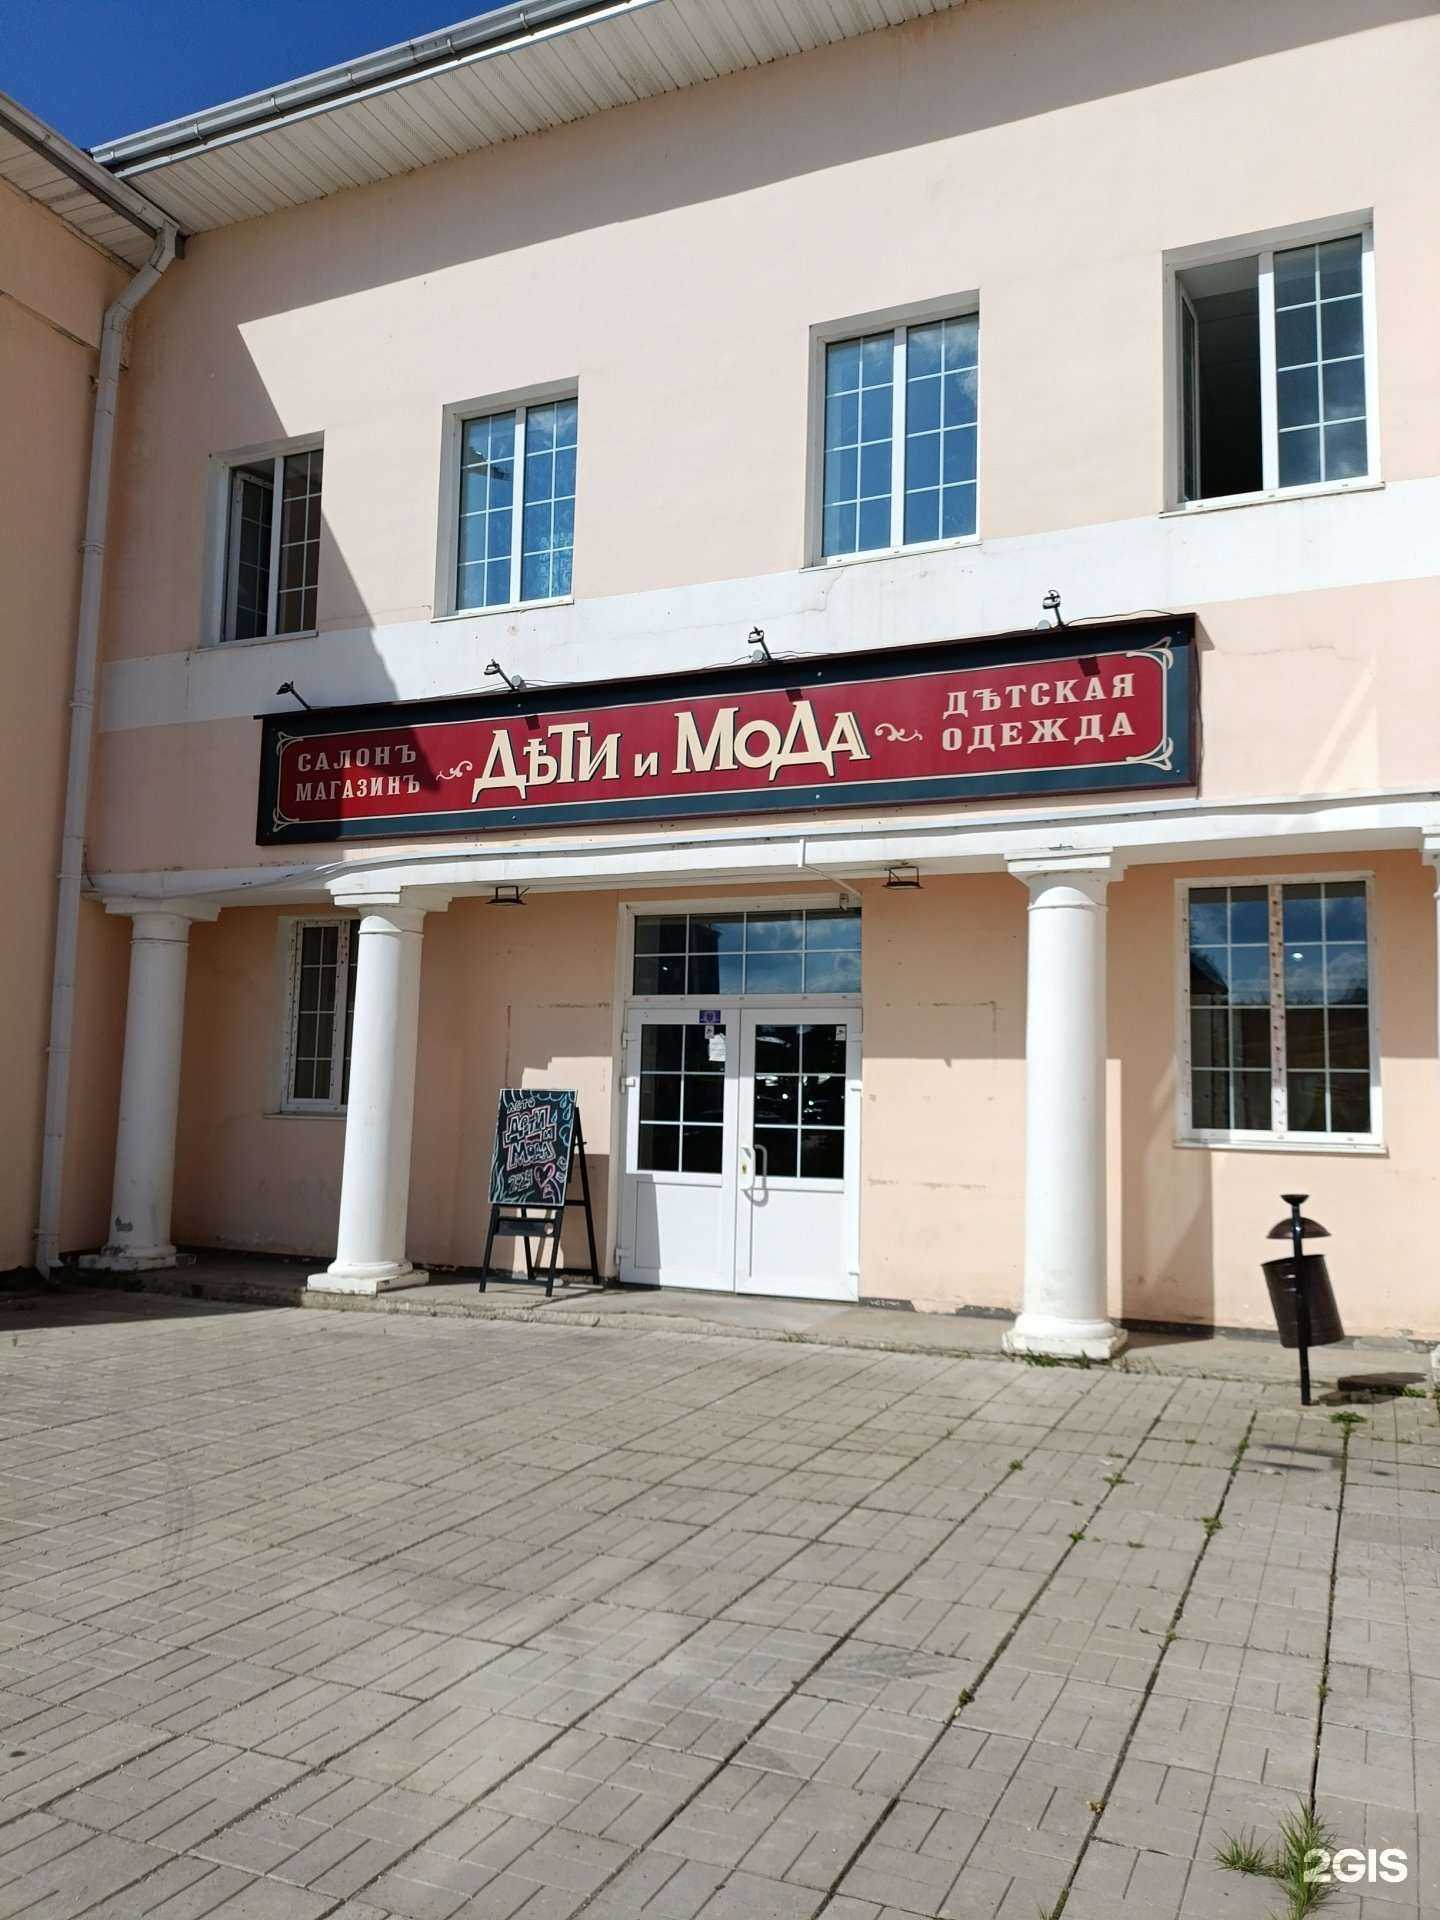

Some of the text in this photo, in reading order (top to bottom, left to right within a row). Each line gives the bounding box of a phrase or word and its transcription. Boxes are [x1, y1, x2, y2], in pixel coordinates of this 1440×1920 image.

[943, 672, 1136, 720] ДѢТСКАЯ
[942, 711, 1137, 755] ОДЕЖДА
[297, 744, 418, 773] САЛОНЪ
[295, 774, 422, 802] МАГАЗИНЪ
